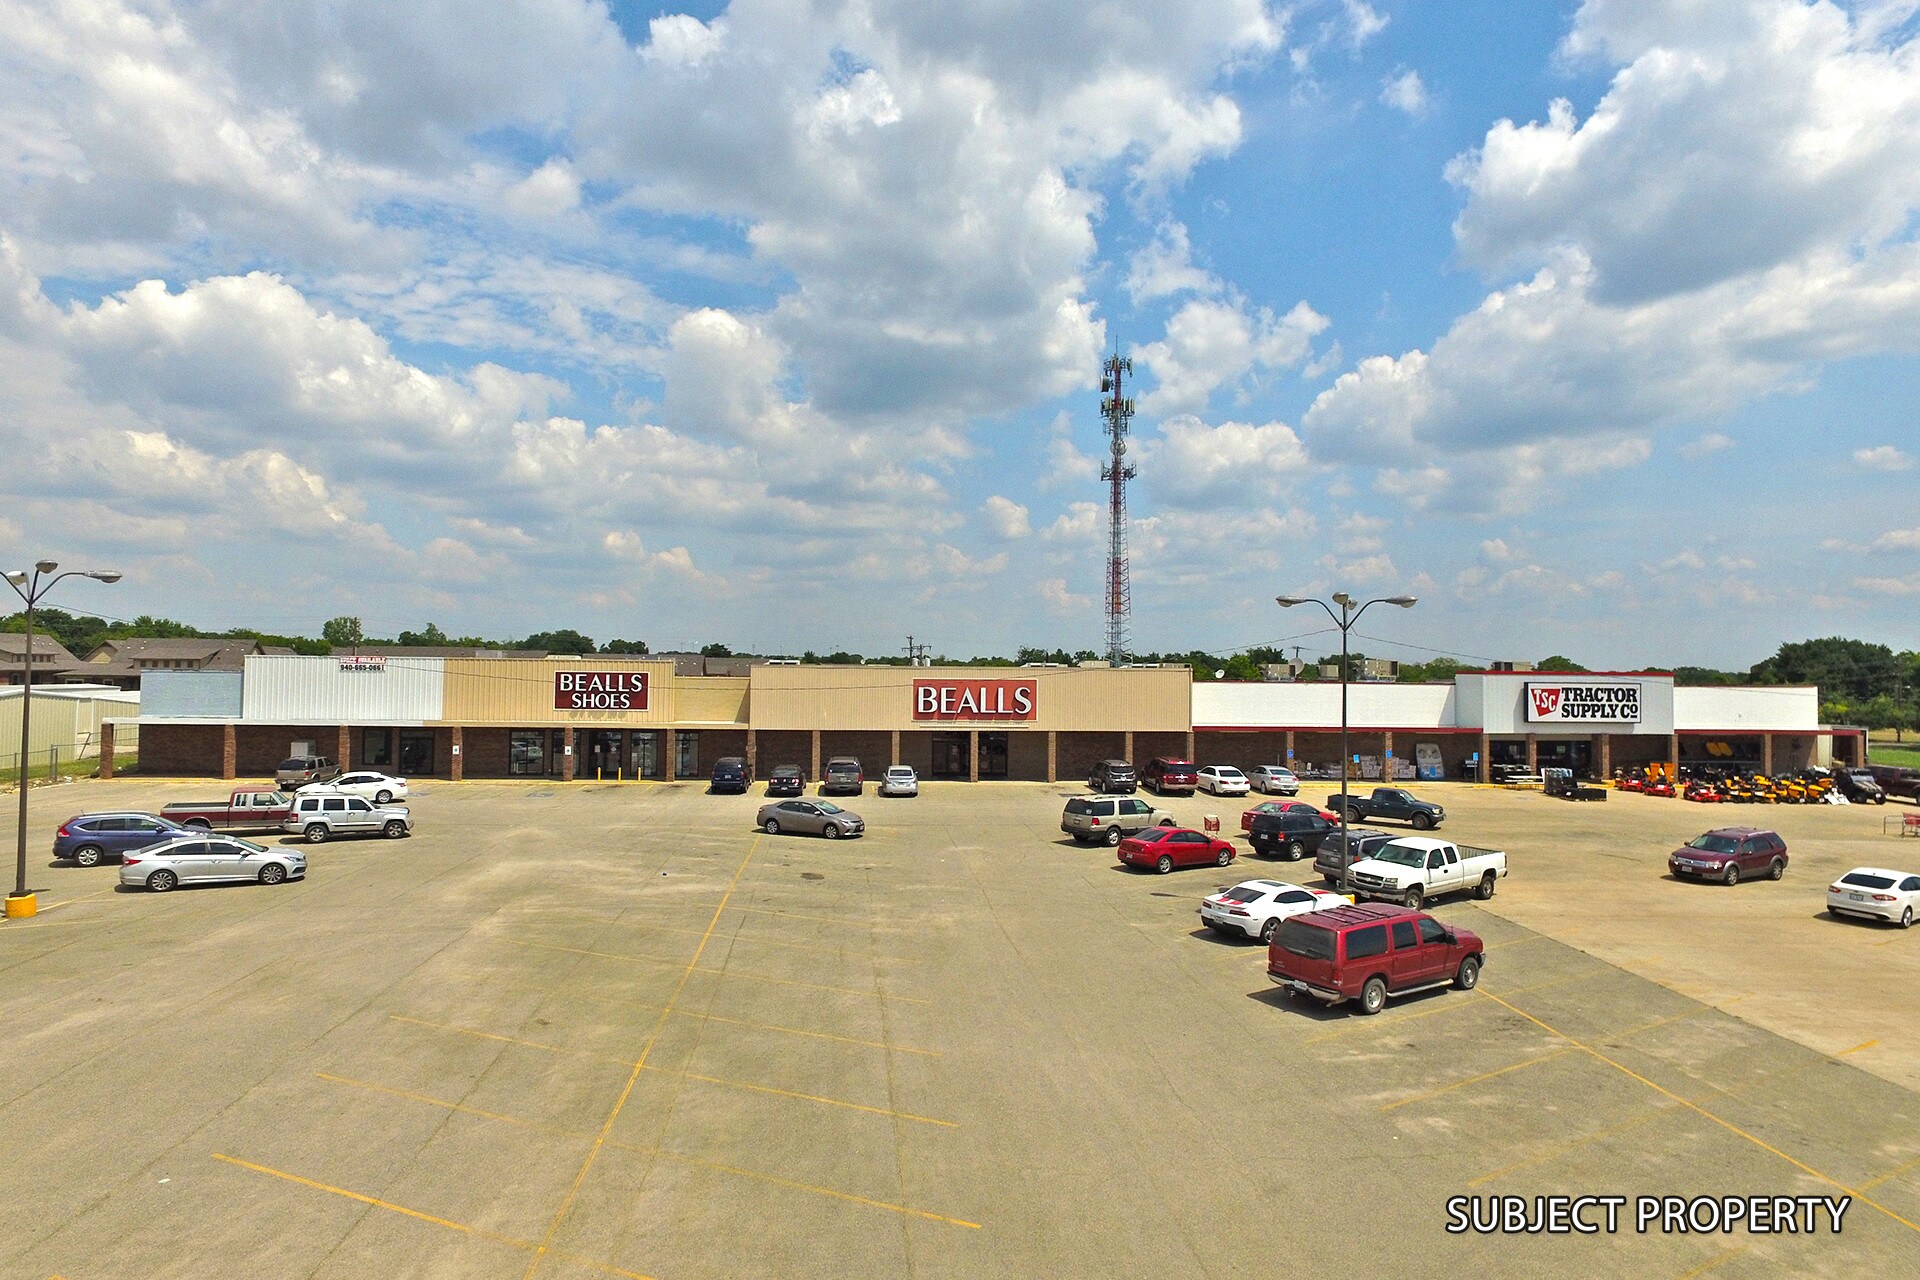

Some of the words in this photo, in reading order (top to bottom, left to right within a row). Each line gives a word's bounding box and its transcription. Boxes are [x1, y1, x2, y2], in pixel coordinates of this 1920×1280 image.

[560, 673, 643, 692] BEALLS
[571, 693, 631, 709] SHOES
[917, 686, 1032, 714] BEALLS
[1534, 689, 1556, 711] TSC
[1561, 687, 1638, 703] TRACTOR
[1561, 703, 1619, 719] SUPPLY
